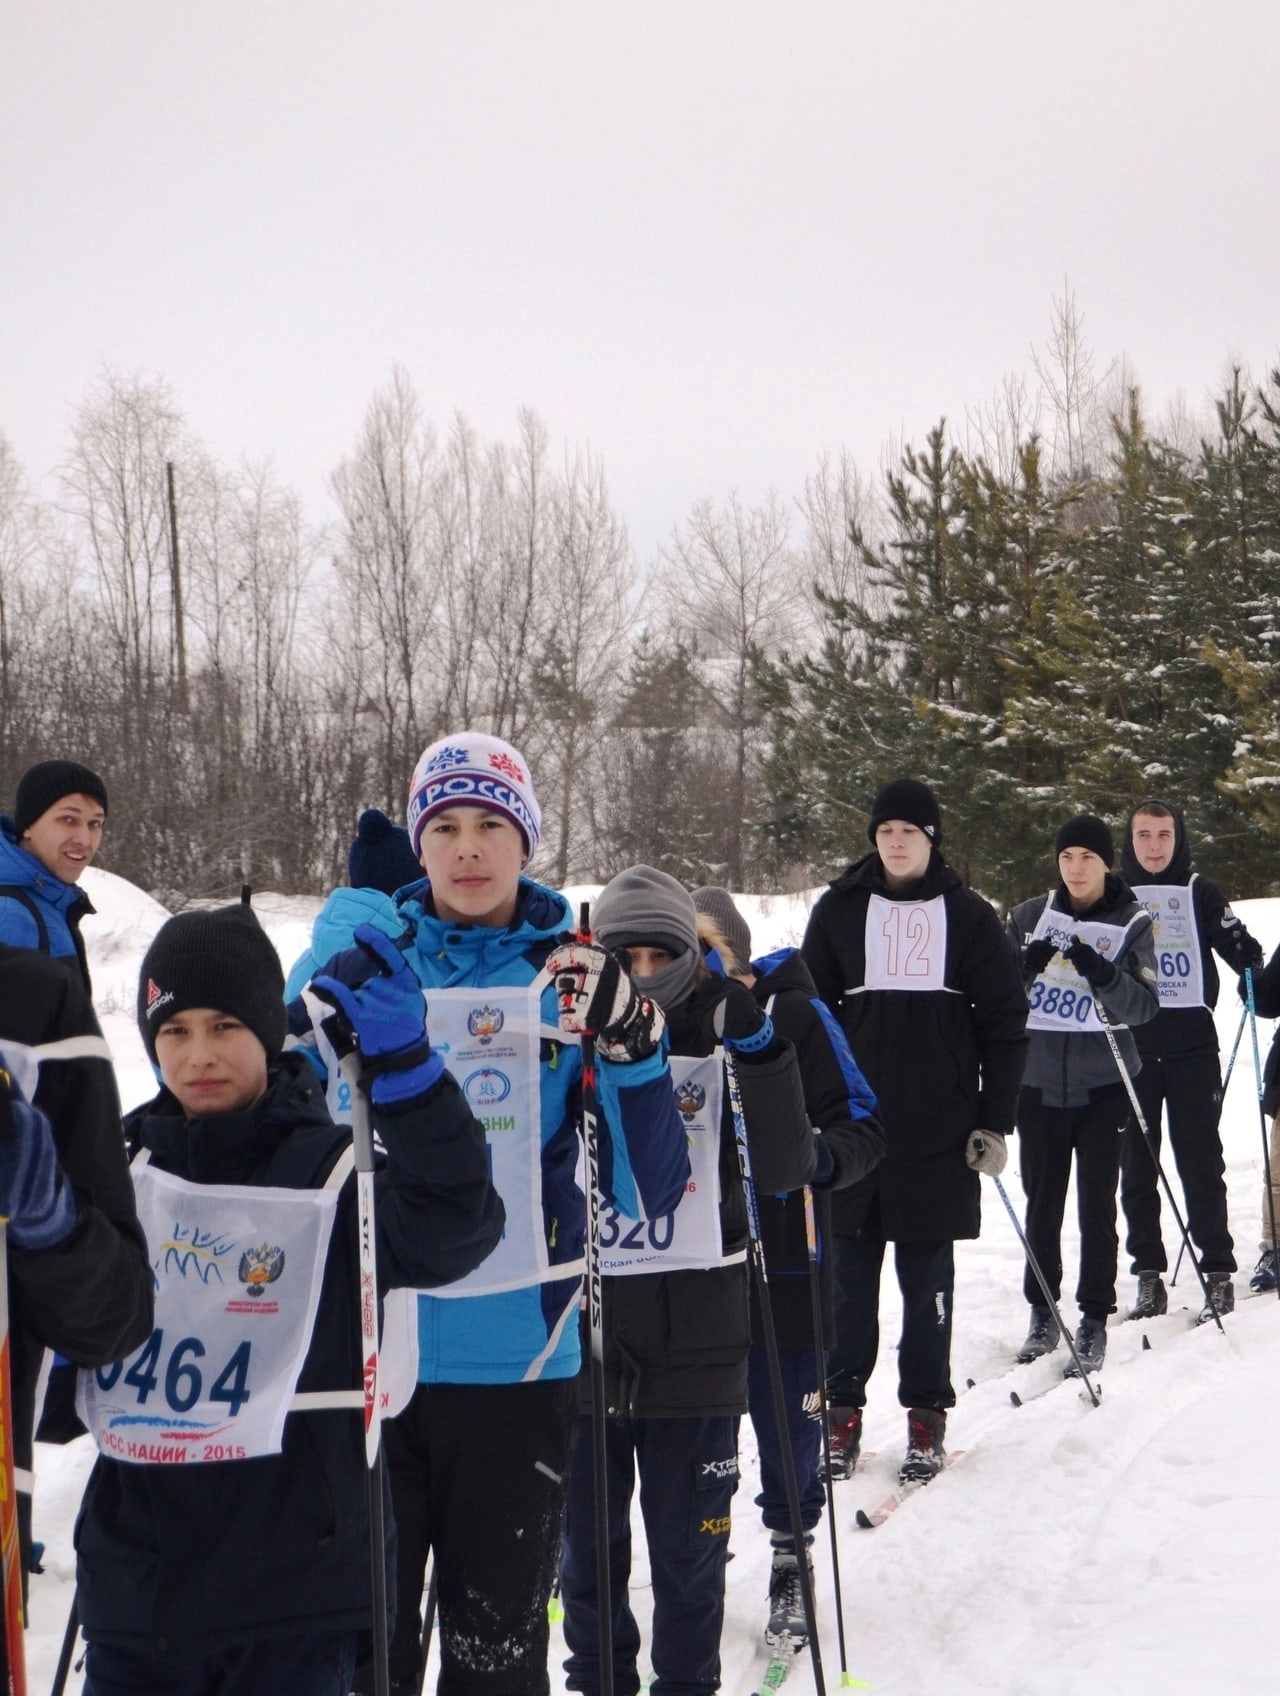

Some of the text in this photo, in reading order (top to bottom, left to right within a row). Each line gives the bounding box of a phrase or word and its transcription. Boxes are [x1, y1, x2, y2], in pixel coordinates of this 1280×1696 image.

[882, 906, 931, 976] 12
[1028, 981, 1093, 1024] 3880
[587, 1118, 602, 1330] MADSHUS
[127, 1441, 187, 1464] НАЦИИ
[203, 1444, 246, 1461] 2015
